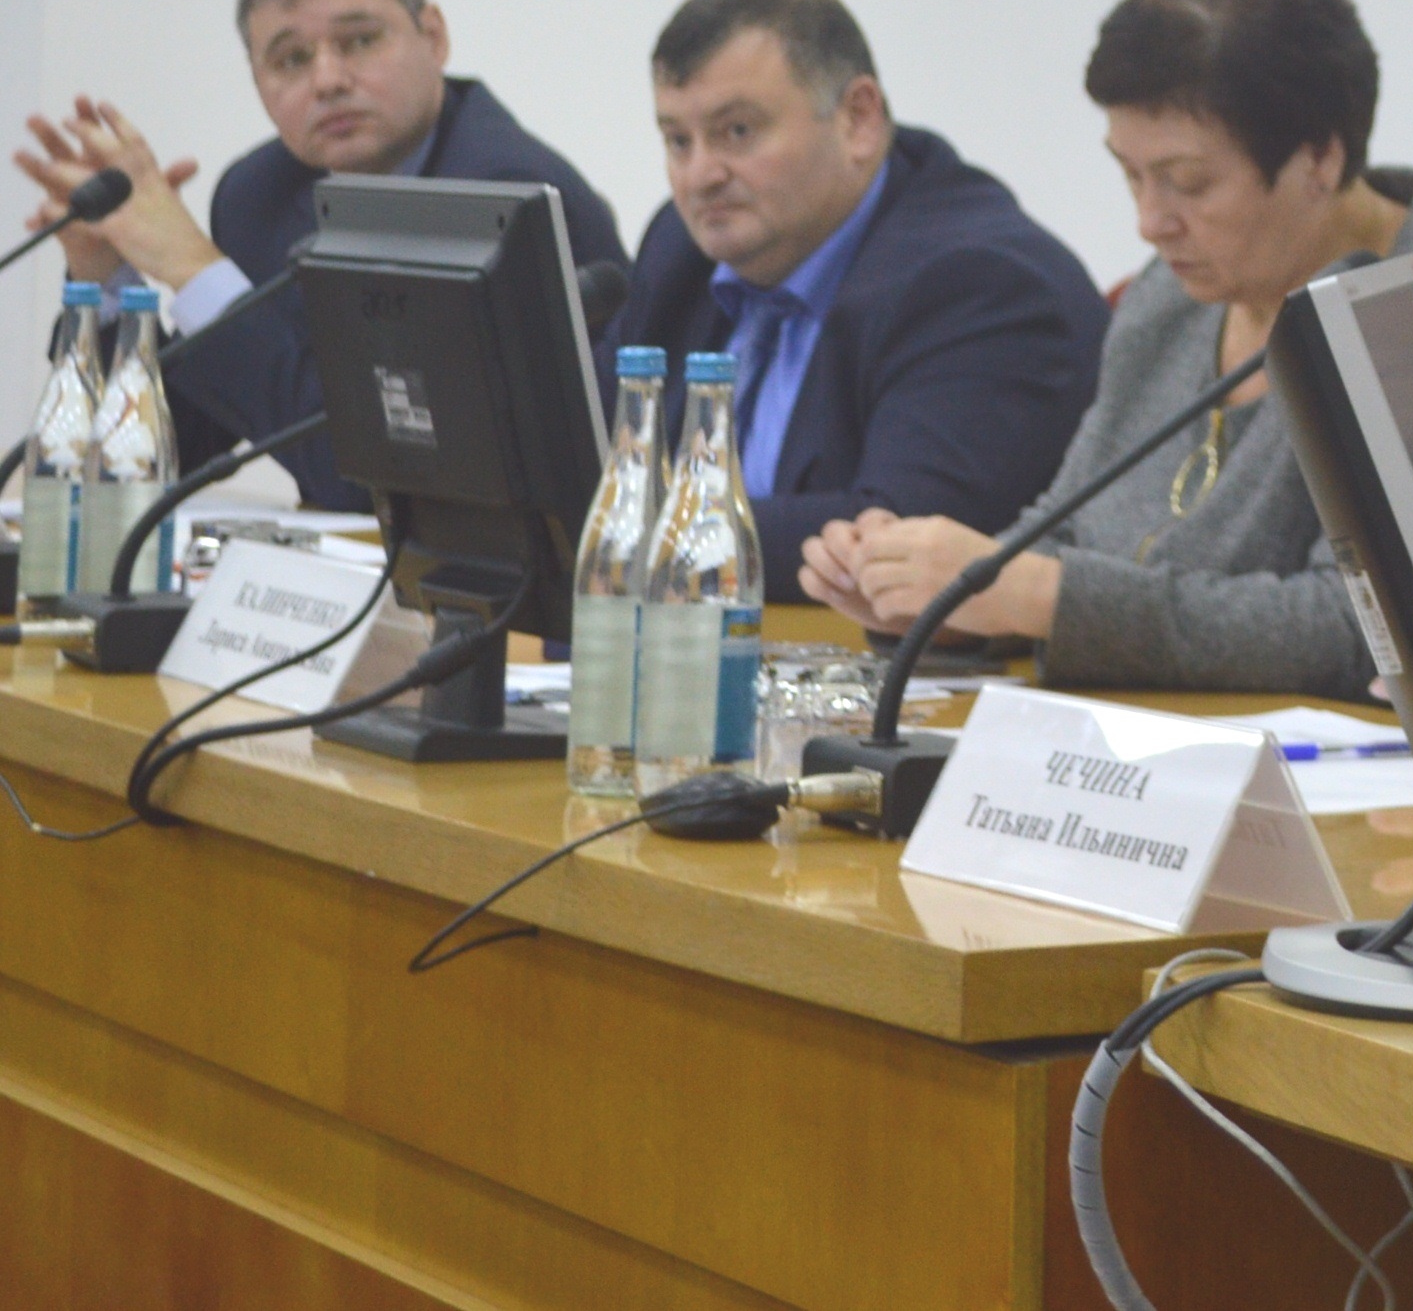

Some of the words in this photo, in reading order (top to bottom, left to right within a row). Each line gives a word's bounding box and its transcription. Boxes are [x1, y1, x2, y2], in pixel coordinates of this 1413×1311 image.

[1046, 749, 1151, 800] ЧЕЧИНА
[965, 793, 1054, 841] Татьяна
[1056, 812, 1189, 871] Ильинична
